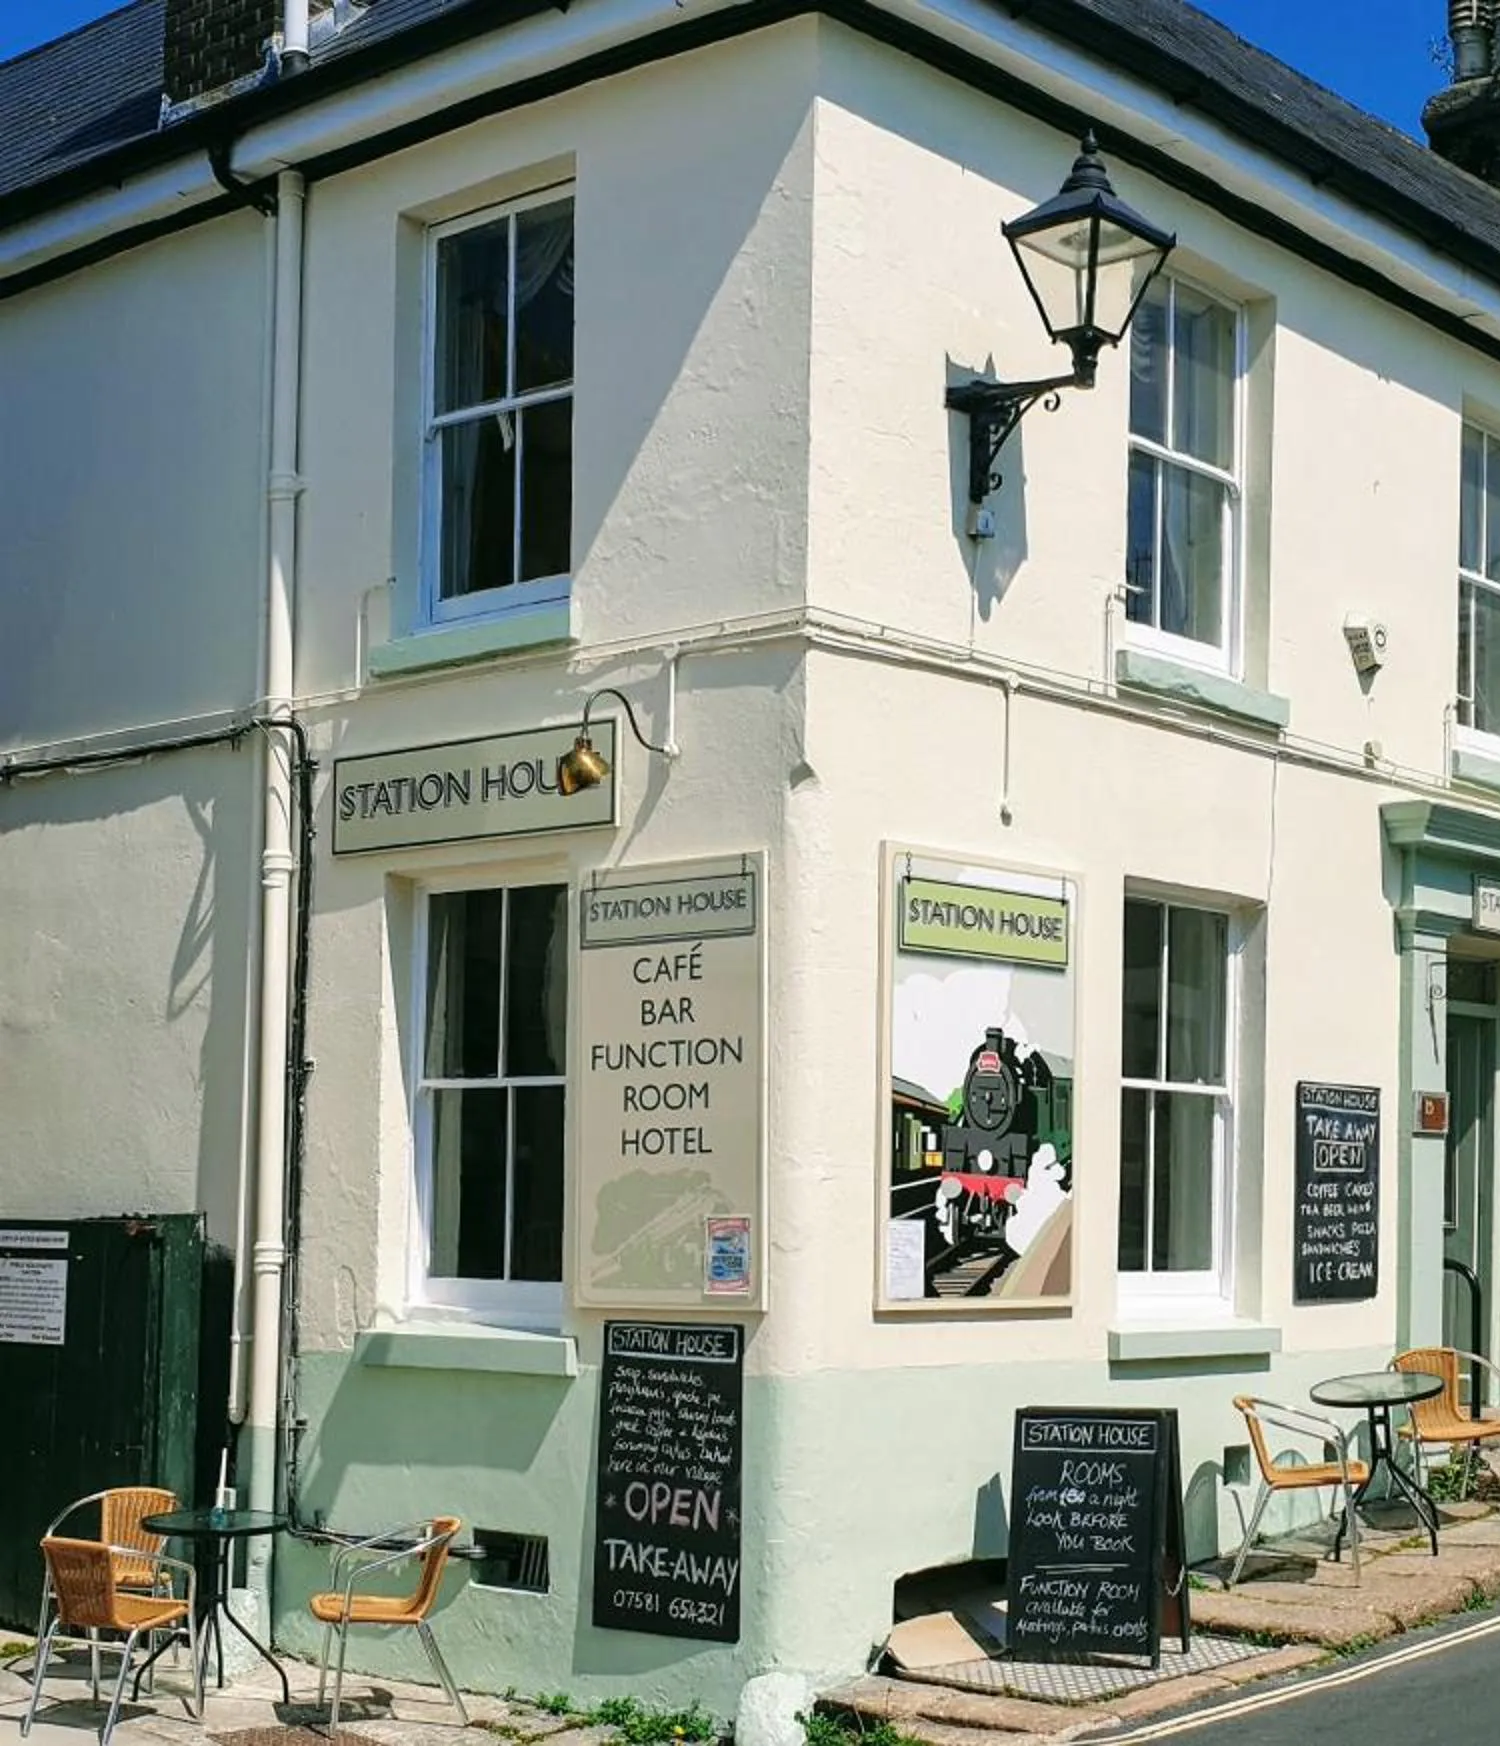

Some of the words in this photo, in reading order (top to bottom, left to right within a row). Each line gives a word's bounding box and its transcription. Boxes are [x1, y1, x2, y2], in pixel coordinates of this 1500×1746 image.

[339, 768, 472, 821] STATION
[481, 755, 560, 801] HOU
[588, 897, 671, 923] STATION
[678, 888, 748, 914] HOUSE
[908, 896, 995, 934] STATION
[999, 910, 1064, 943] HOUSE
[632, 943, 704, 985] CAFÉ
[640, 996, 695, 1027] BAR
[590, 1036, 743, 1072] FUNCTION
[623, 1082, 710, 1114] ROOM
[1303, 1088, 1342, 1105] STATION
[1343, 1093, 1378, 1110] HOUSE
[620, 1127, 713, 1157] HOTEL
[1306, 1114, 1340, 1140] TAKE
[1345, 1121, 1377, 1146] AWAY
[1318, 1145, 1361, 1167] OPEN
[1307, 1183, 1339, 1199] COFFEE
[1301, 1203, 1320, 1216] TEA
[613, 1327, 671, 1353] STATION
[676, 1331, 728, 1357] HOUSE
[1027, 1422, 1094, 1446] STATION
[1099, 1422, 1150, 1447] HOUSE
[1058, 1459, 1128, 1487] ROOMS
[624, 1481, 722, 1532] OPEN
[1069, 1511, 1130, 1531] BEFORE
[1055, 1530, 1085, 1554] YOU
[1089, 1534, 1137, 1554] BOOK
[602, 1538, 740, 1597] TAKE-AWAY
[1019, 1573, 1091, 1600] FUNCTION
[1096, 1580, 1140, 1603] ROOM
[612, 1588, 660, 1614] 07581
[668, 1596, 726, 1628] 654321
